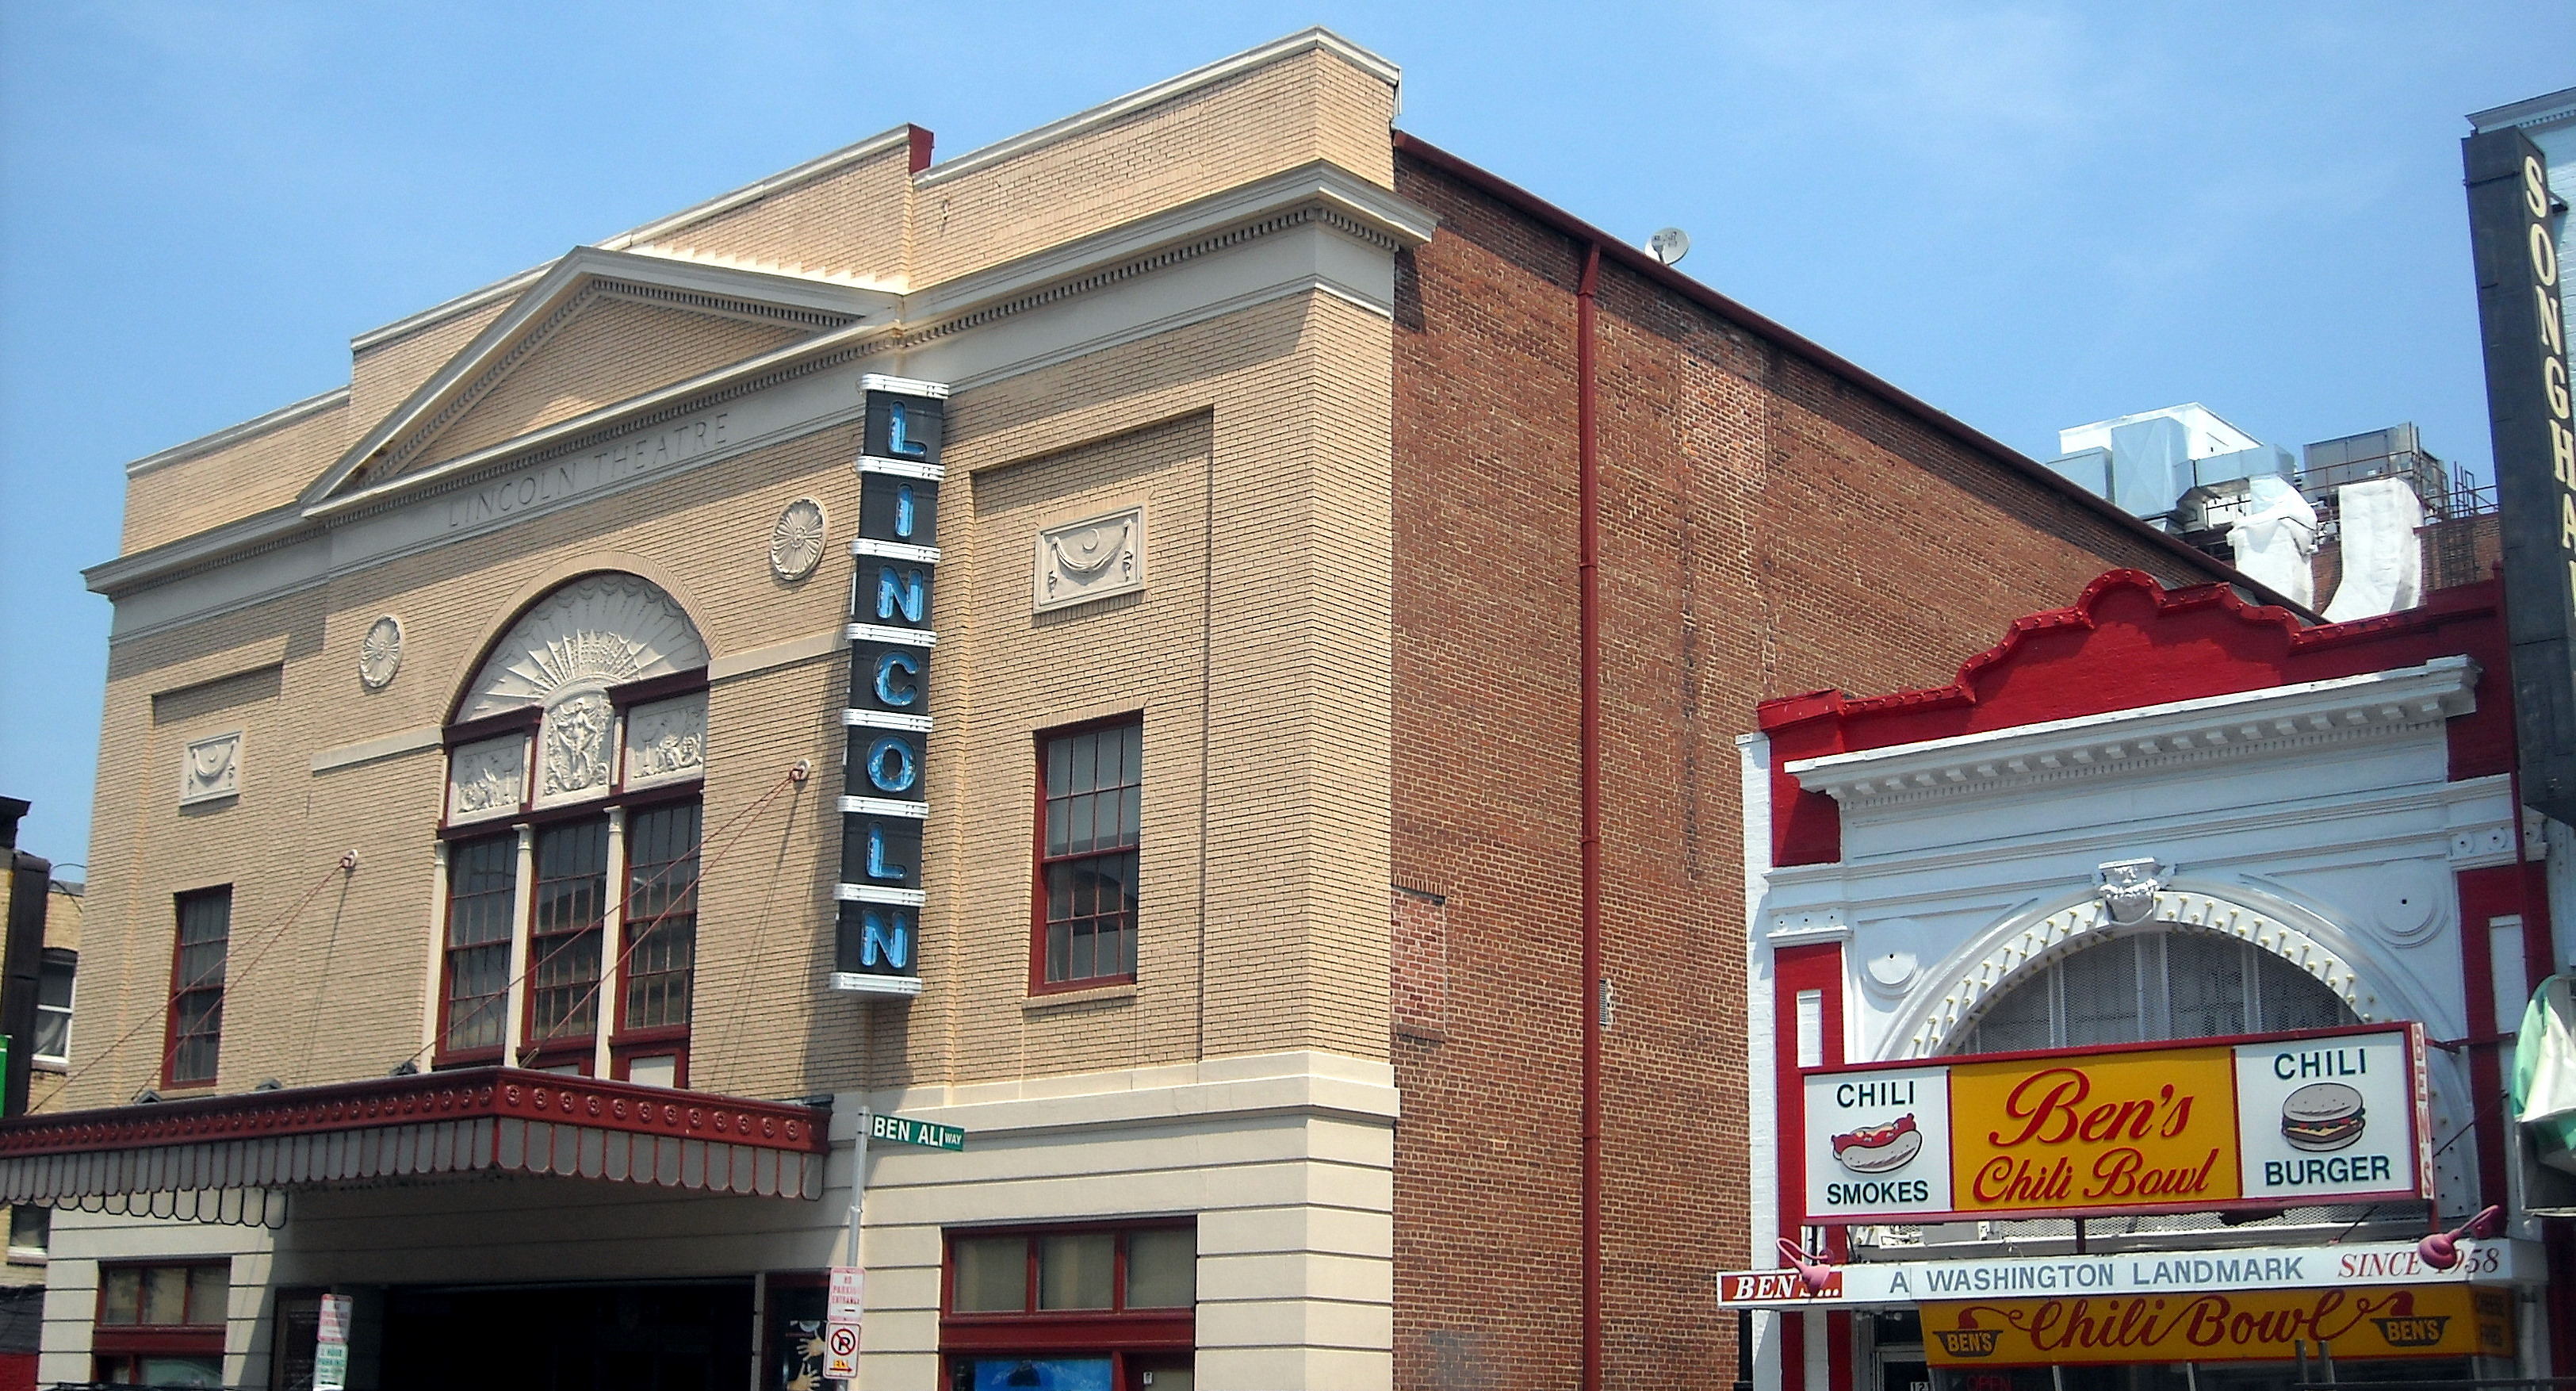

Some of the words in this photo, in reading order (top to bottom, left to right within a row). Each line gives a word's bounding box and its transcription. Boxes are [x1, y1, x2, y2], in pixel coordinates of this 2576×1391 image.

[449, 462, 577, 528] LINCOLN
[593, 412, 730, 484] THEATRE
[860, 399, 928, 971] LINCOLN
[2273, 1048, 2367, 1079] CHILI
[1836, 1081, 1916, 1108] CHILI
[1988, 1067, 2195, 1148] Ben's
[873, 1116, 911, 1141] BEN
[917, 1124, 944, 1147] ALI
[944, 1132, 962, 1144] WAY
[1973, 1155, 2074, 1203] Chili
[2083, 1147, 2219, 1198] Bowl
[2265, 1155, 2390, 1186] BURGER
[1827, 1180, 1929, 1205] SMOKES
[1889, 1271, 1910, 1293] A
[1927, 1263, 2115, 1292] WASHINGTON
[2132, 1256, 2303, 1286] LANDMARK
[2338, 1251, 2422, 1278] SINCE
[2434, 1247, 2500, 1275] 958
[2029, 1295, 2169, 1351] Chili
[2180, 1289, 2353, 1347] Bowl
[2387, 1316, 2440, 1342] BEN'S
[1946, 1331, 1993, 1353] BEN'S
